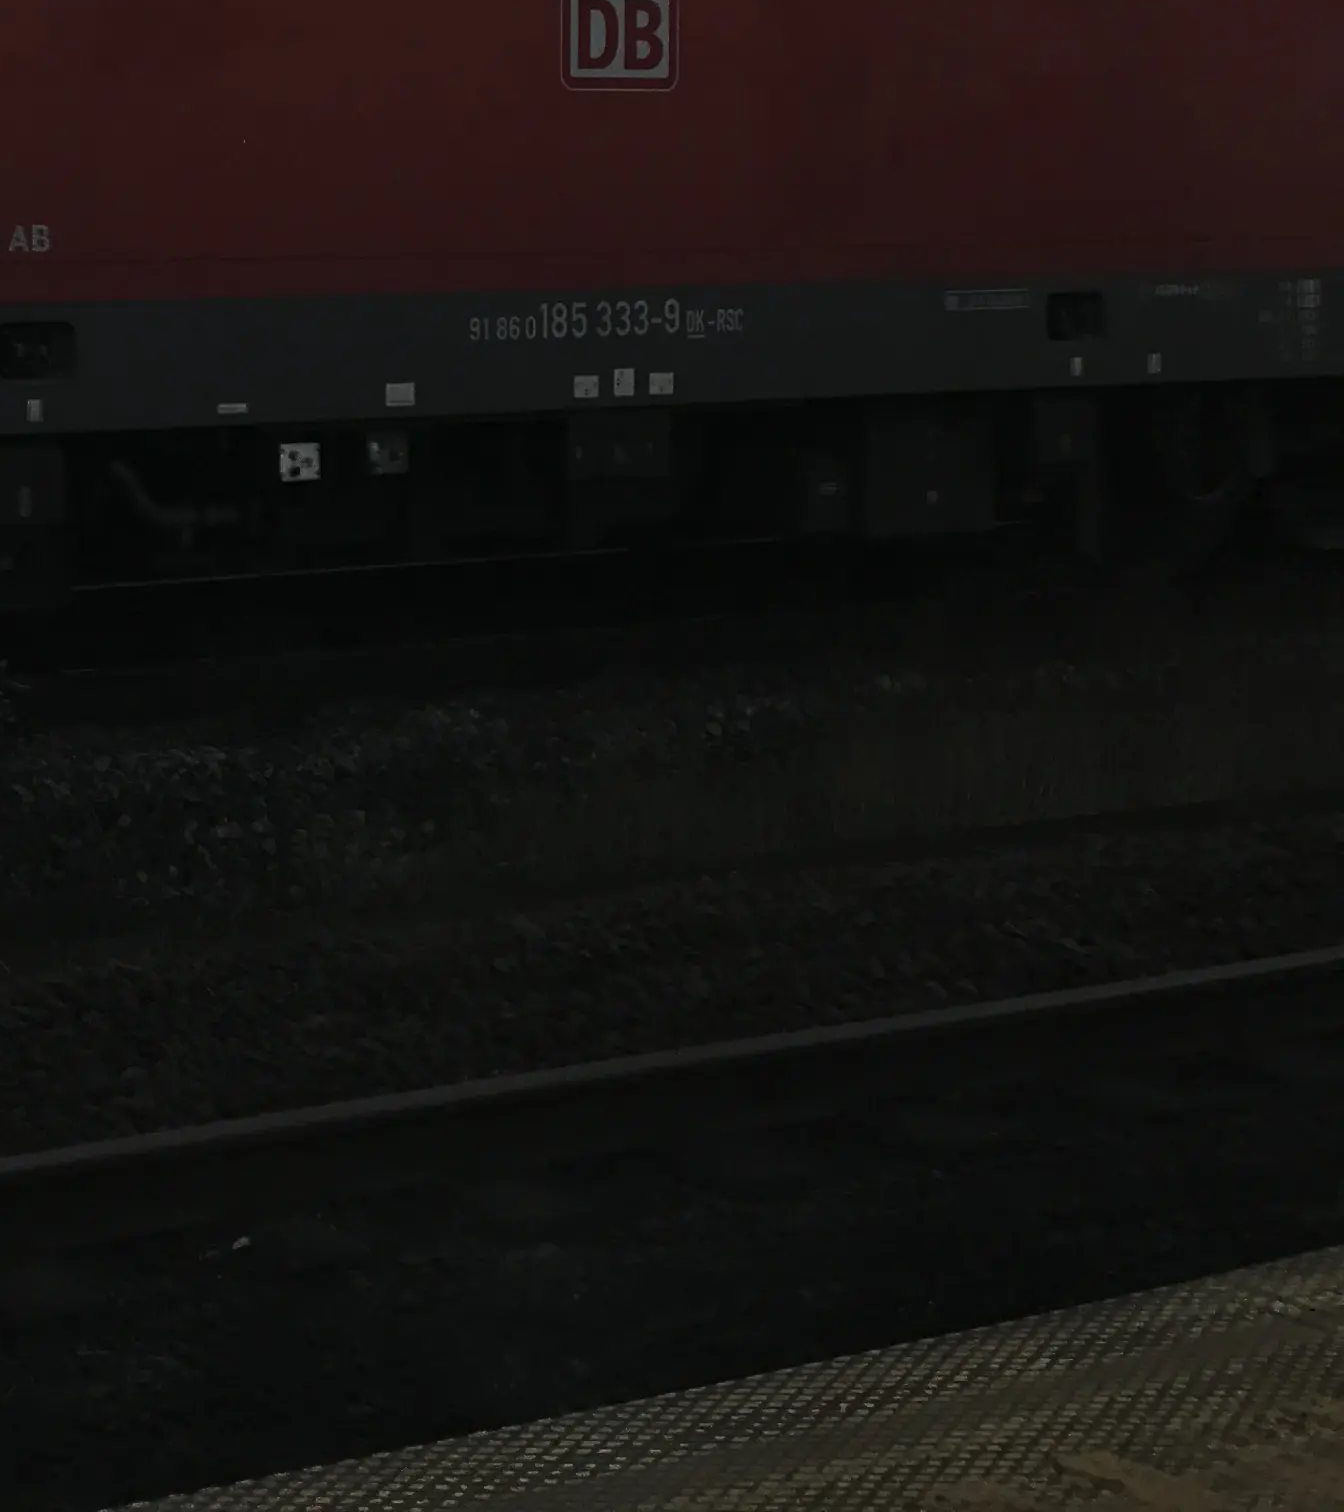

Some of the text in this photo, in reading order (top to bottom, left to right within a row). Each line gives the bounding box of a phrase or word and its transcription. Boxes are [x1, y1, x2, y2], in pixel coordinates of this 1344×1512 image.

[7, 223, 52, 254] AB
[468, 316, 490, 341] 91
[495, 315, 521, 340] 86
[595, 297, 681, 337] 333-9
